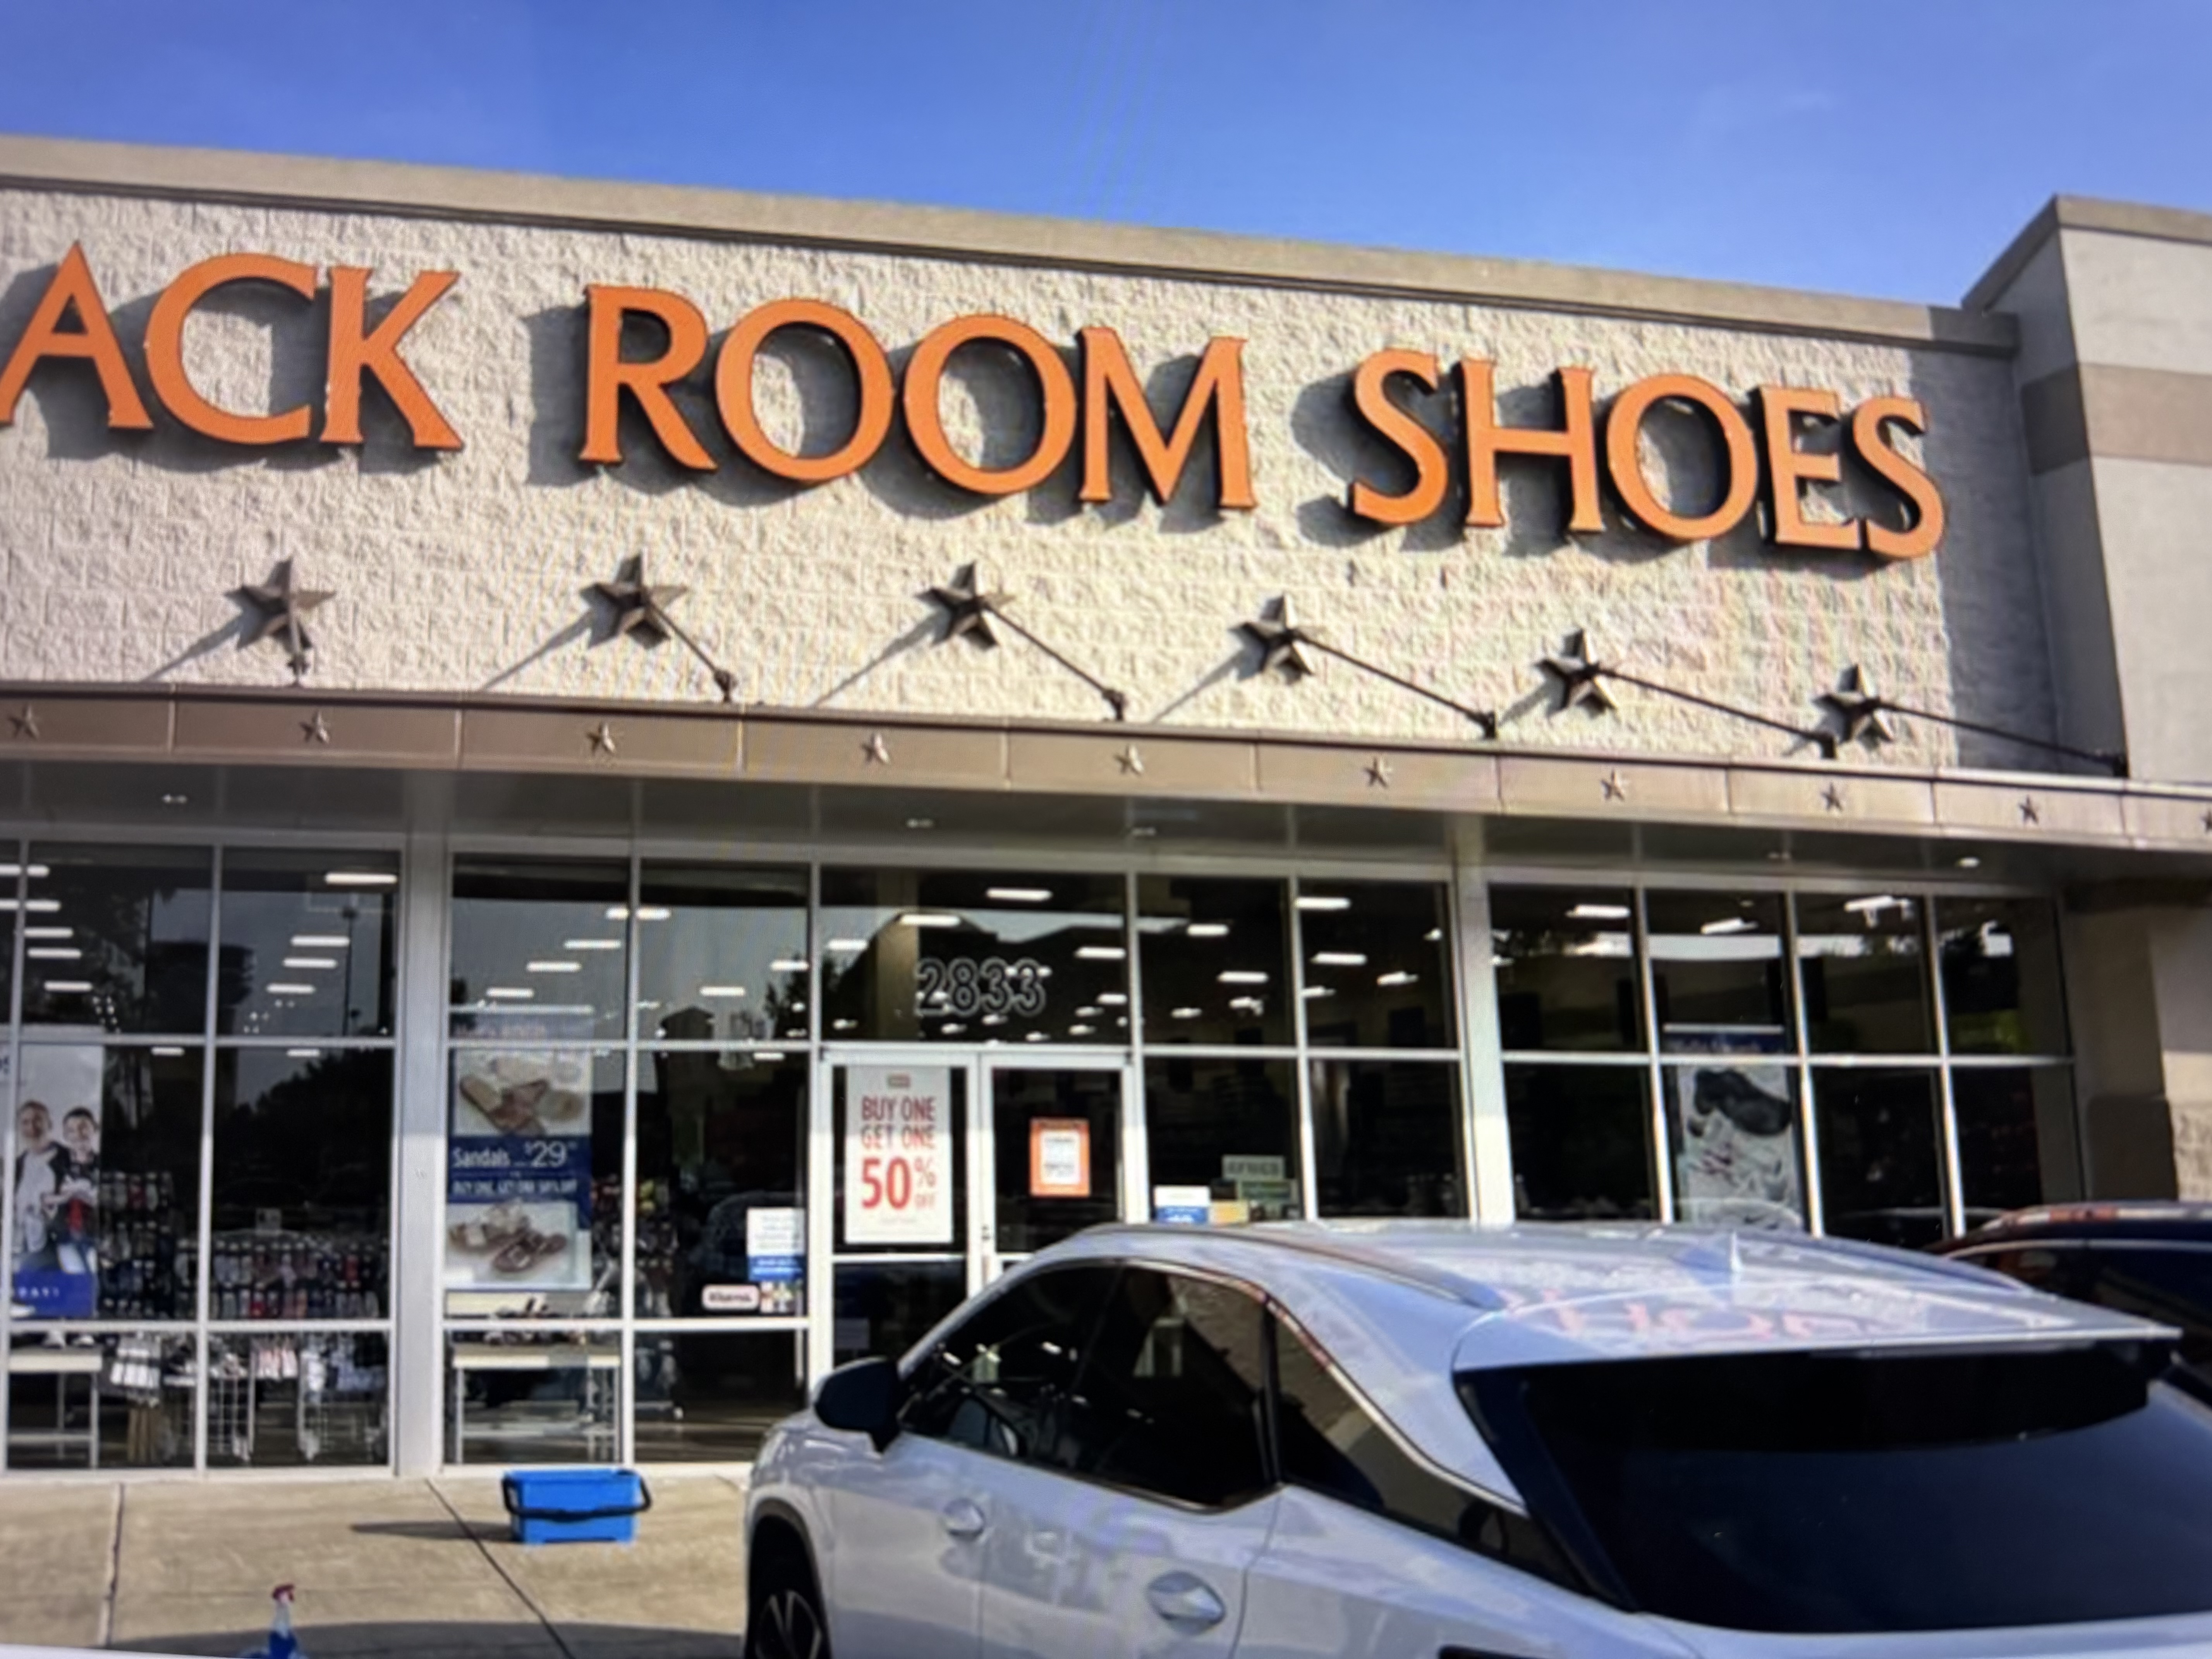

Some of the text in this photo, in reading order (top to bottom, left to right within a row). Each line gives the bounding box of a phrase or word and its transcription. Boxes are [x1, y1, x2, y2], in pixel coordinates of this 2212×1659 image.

[0, 240, 1946, 560] ACK ROOM SHOES
[914, 957, 1046, 1017] 2833
[862, 1096, 936, 1121] BUY ONE
[860, 1124, 936, 1149] GET ONE
[452, 1146, 511, 1168] Sandals
